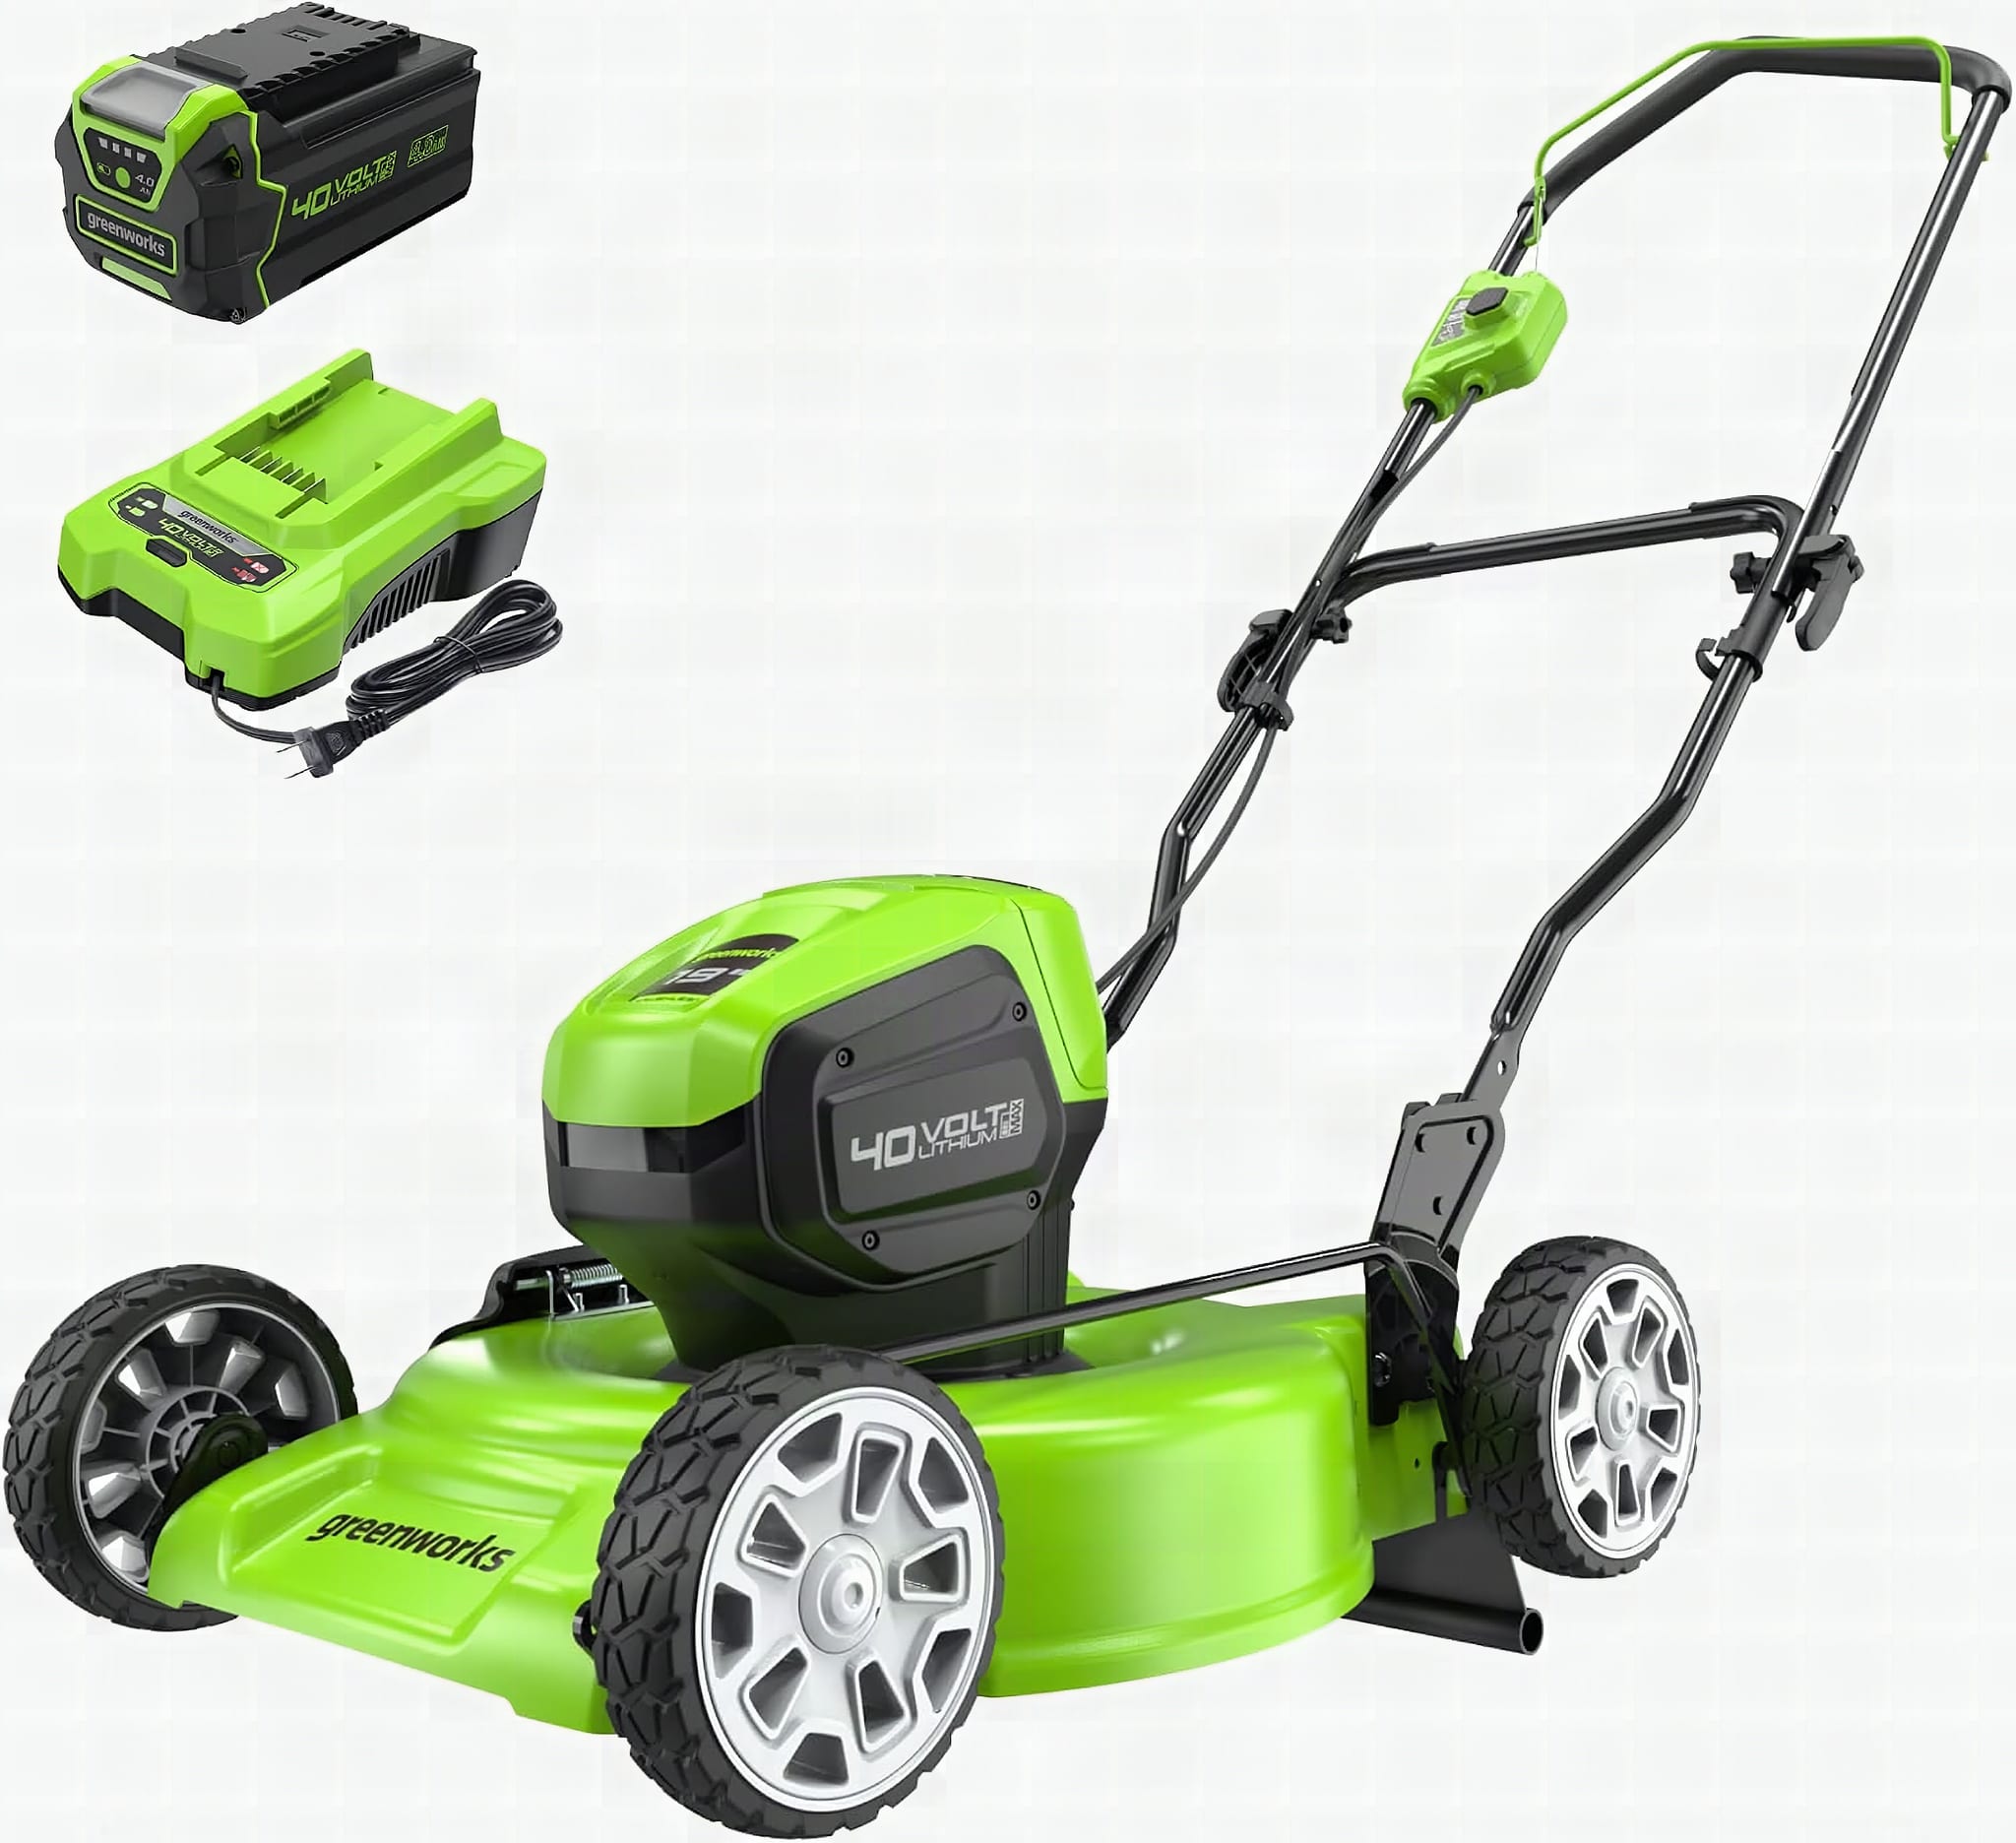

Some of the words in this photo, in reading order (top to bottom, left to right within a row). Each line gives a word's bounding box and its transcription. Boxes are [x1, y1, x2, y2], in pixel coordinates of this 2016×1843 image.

[135, 174, 155, 187] 4.0
[291, 182, 332, 220] 40
[335, 156, 387, 194] VOLT
[87, 212, 165, 256] greenworks
[158, 518, 185, 535] 40
[178, 510, 238, 543] greenworks
[1010, 1100, 1024, 1134] MAX
[850, 1124, 916, 1172] 40
[920, 1102, 1008, 1144] VOLT
[917, 1127, 997, 1160] LITHIUM
[305, 1513, 516, 1572] greenworks
